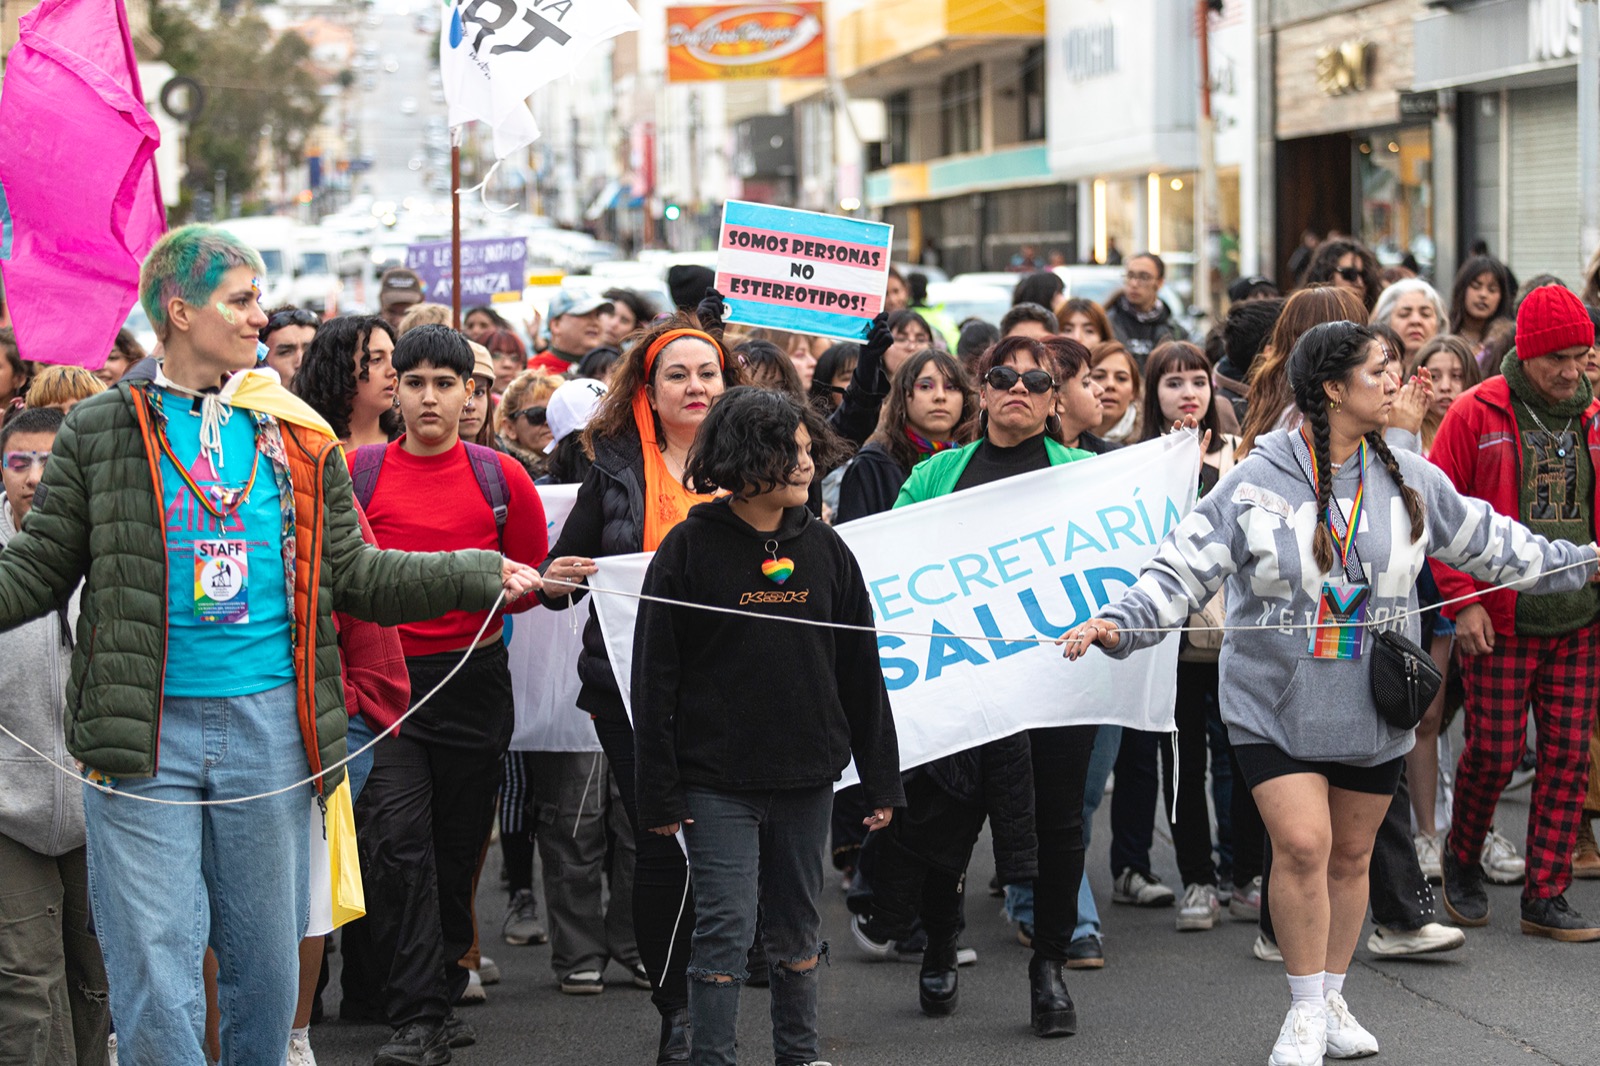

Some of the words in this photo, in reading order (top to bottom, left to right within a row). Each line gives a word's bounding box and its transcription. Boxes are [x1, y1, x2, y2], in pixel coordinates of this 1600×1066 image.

[728, 230, 789, 253] SOMOS
[792, 239, 881, 267] PERSONAS
[790, 262, 815, 280] NO
[730, 277, 867, 312] ESTEREOTIPOS!
[200, 543, 243, 557] STAFF
[872, 487, 1182, 622] ECRETARÍA
